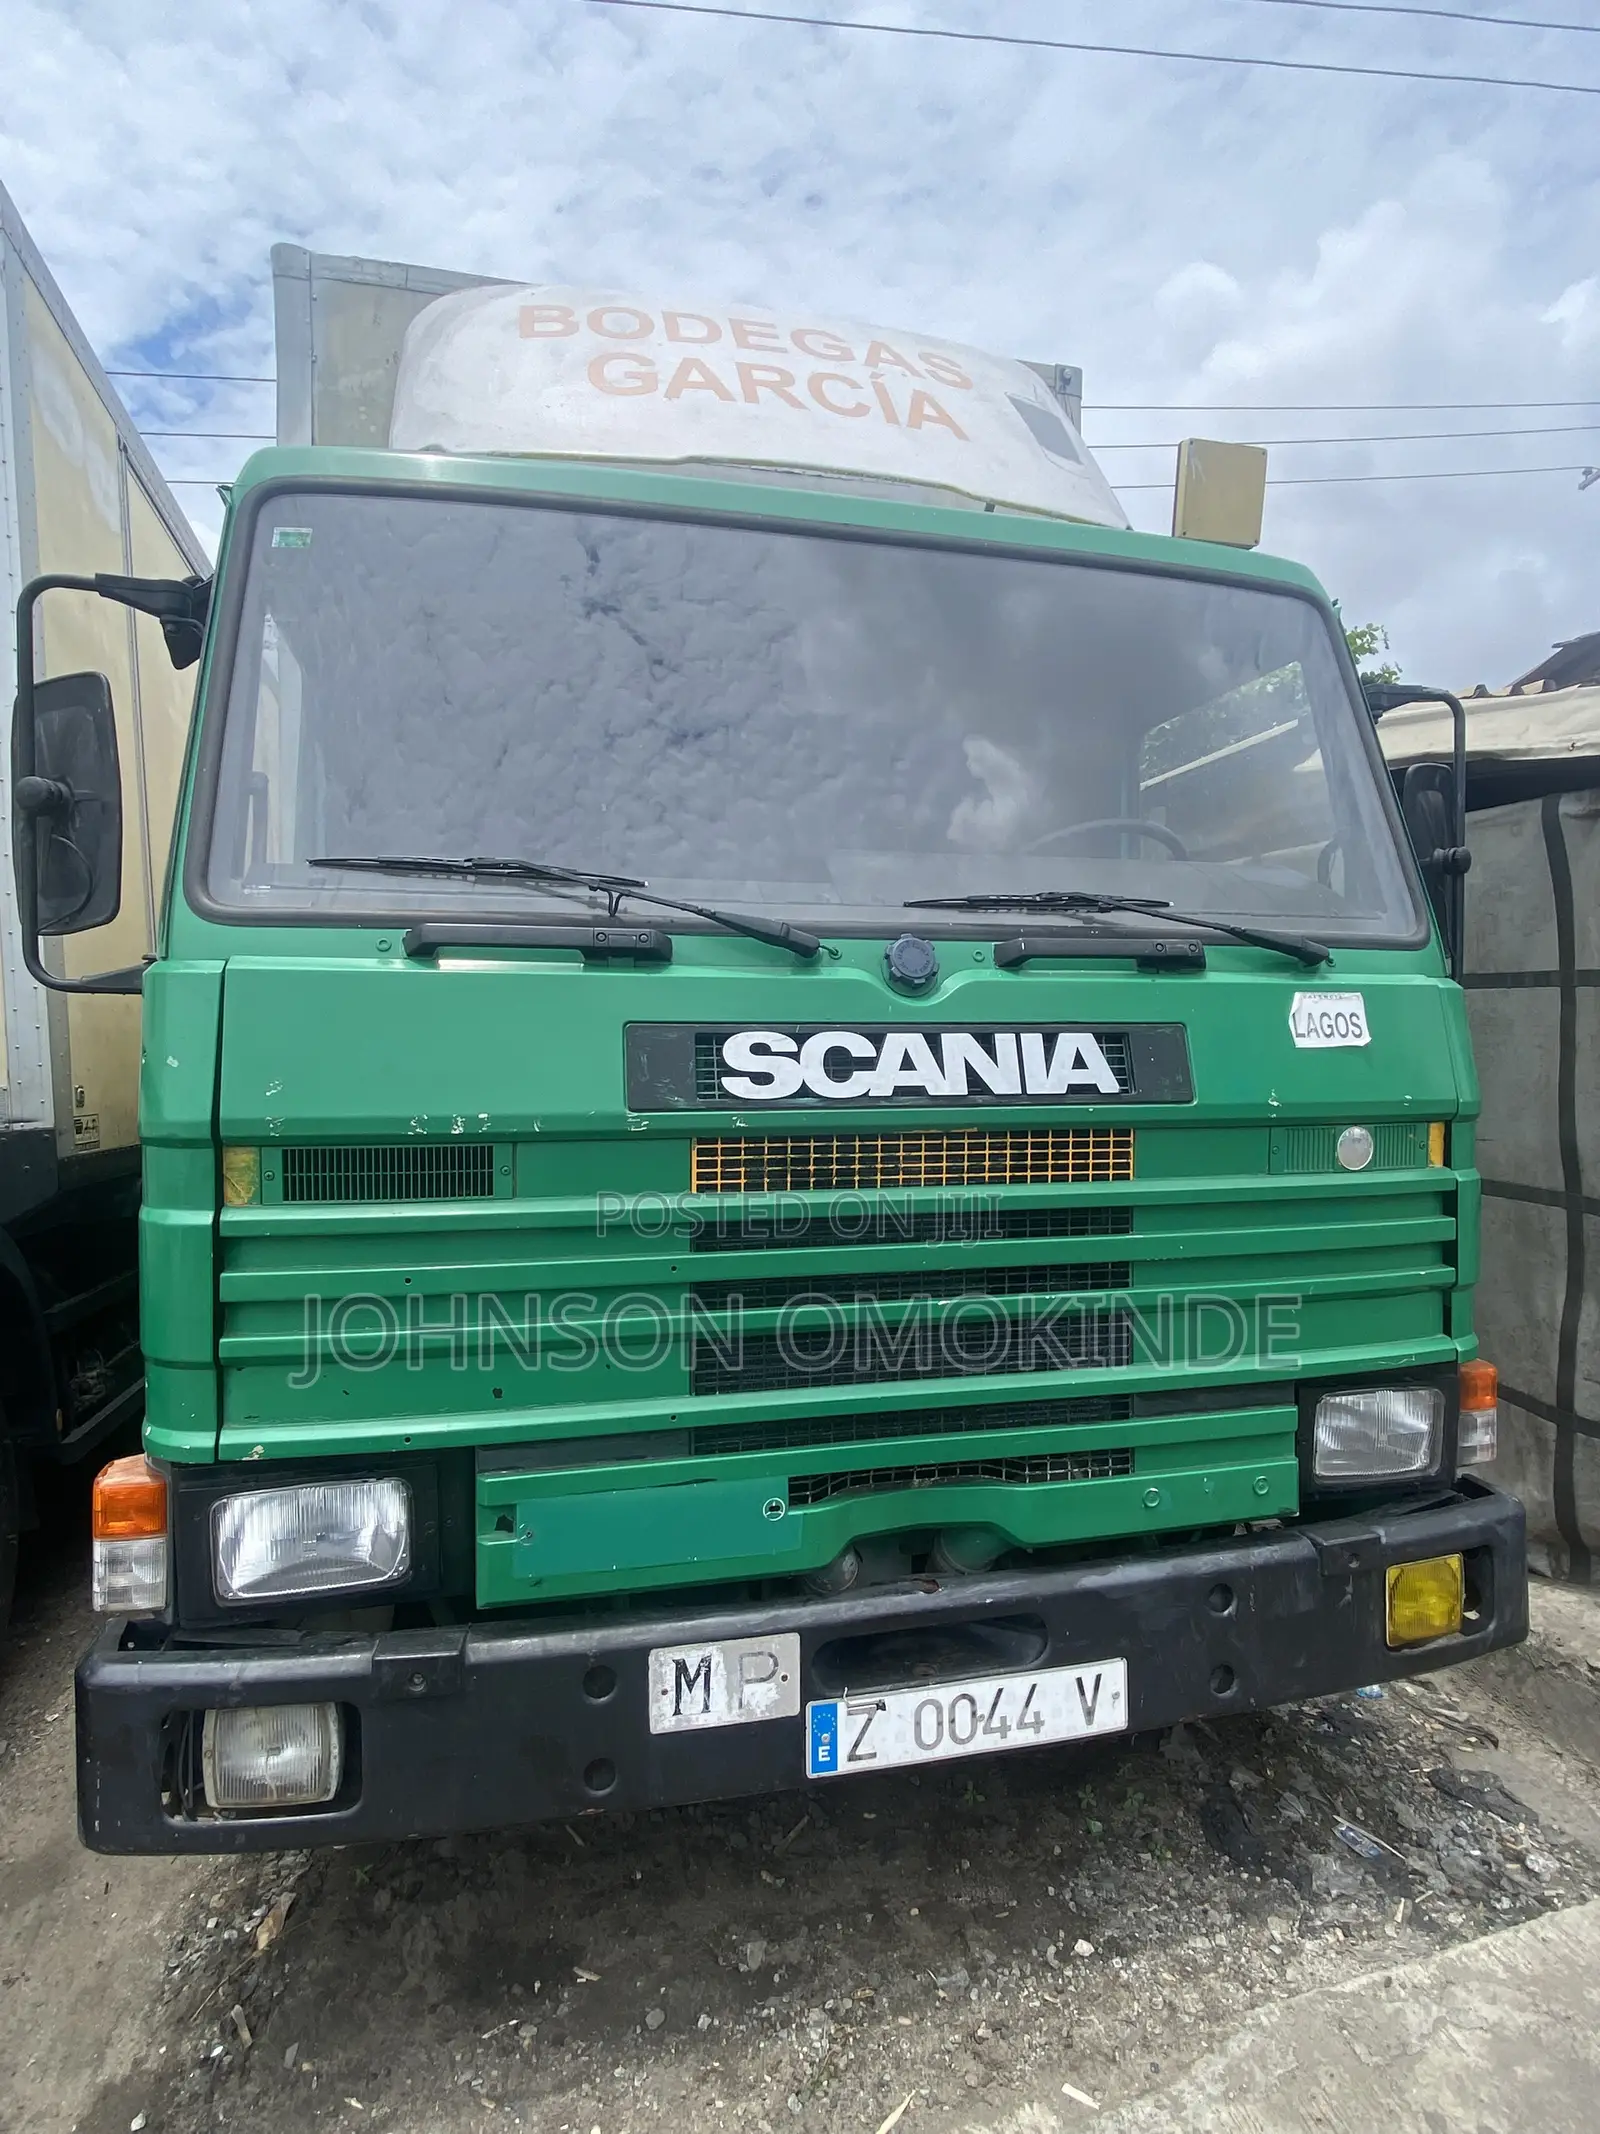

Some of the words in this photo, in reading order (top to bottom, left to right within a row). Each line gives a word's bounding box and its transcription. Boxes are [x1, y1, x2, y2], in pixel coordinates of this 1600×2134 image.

[518, 304, 974, 391] BODEGAS
[587, 352, 971, 442] GARCÍA
[720, 1031, 1121, 1100] SCANIA
[1292, 1011, 1363, 1039] LAGOS
[818, 1745, 831, 1762] E
[846, 1703, 878, 1763] Z
[913, 1683, 1046, 1751] 0044
[1075, 1673, 1103, 1727] V
